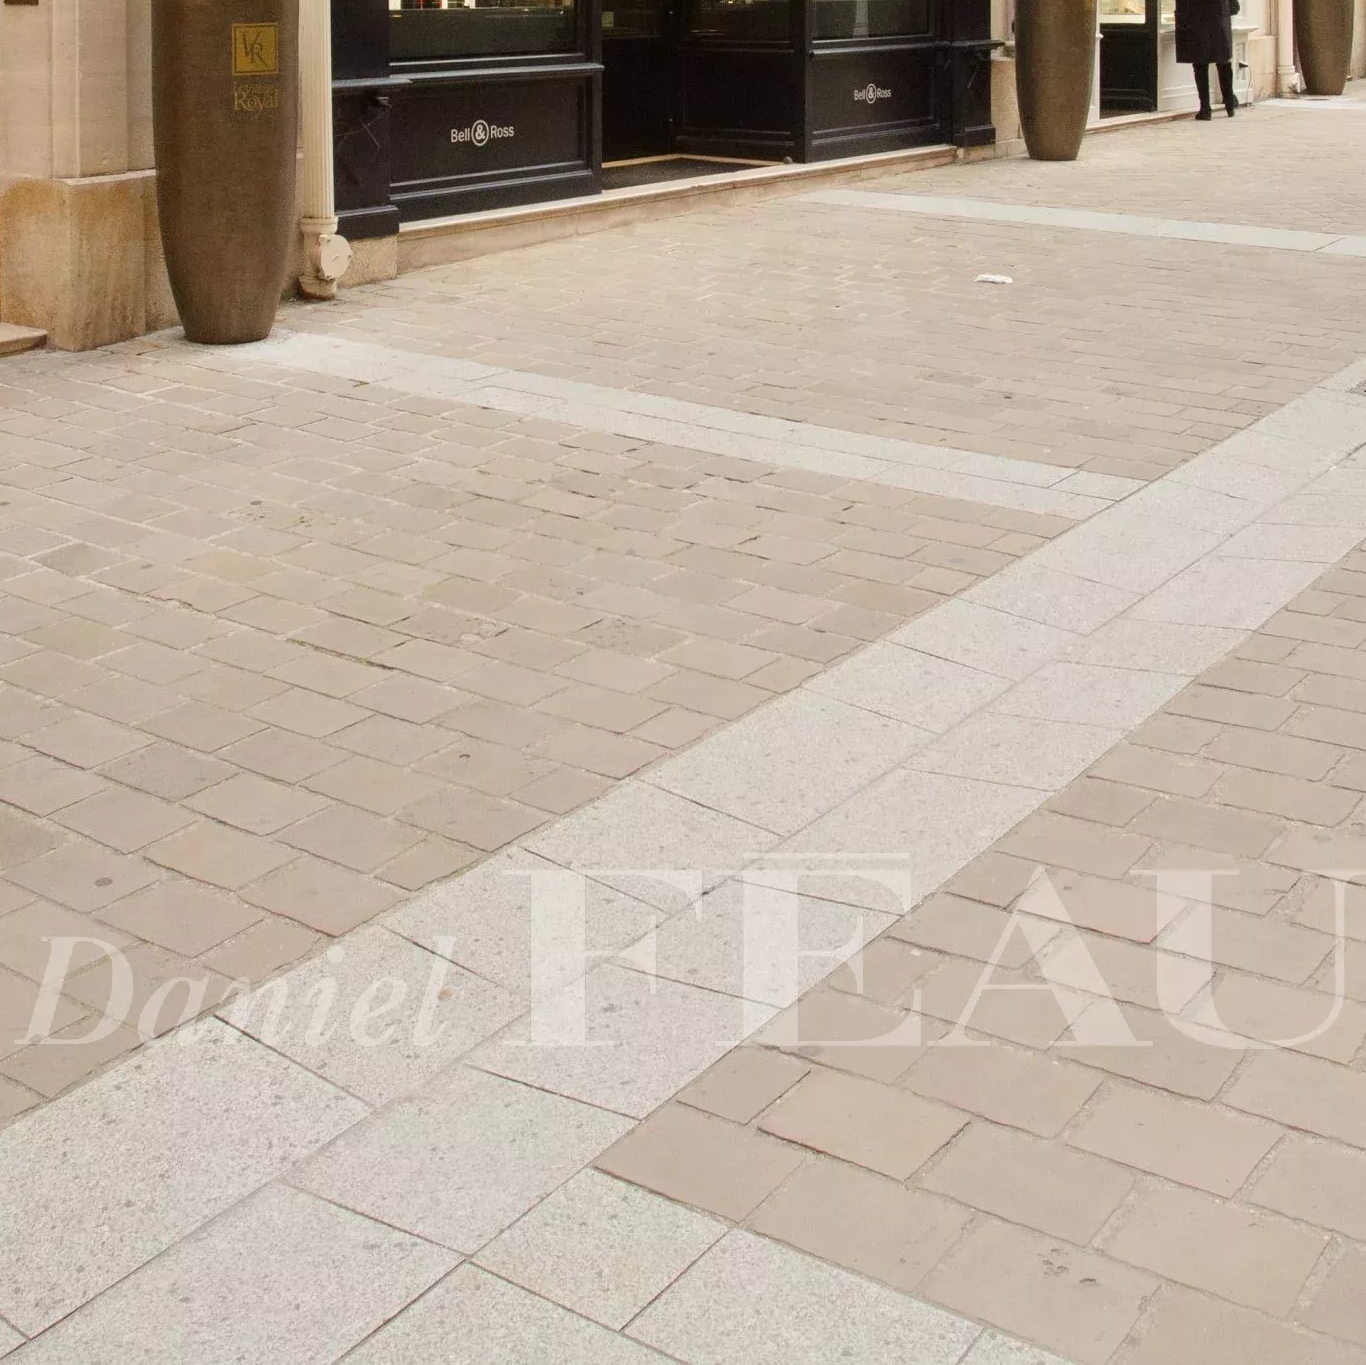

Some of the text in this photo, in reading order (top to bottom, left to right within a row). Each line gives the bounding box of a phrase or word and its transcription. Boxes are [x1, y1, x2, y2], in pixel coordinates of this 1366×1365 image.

[853, 89, 866, 101] Bell
[876, 87, 892, 98] Ross
[234, 90, 279, 118] Royal
[450, 128, 471, 143] Bell
[490, 125, 515, 139] Ross
